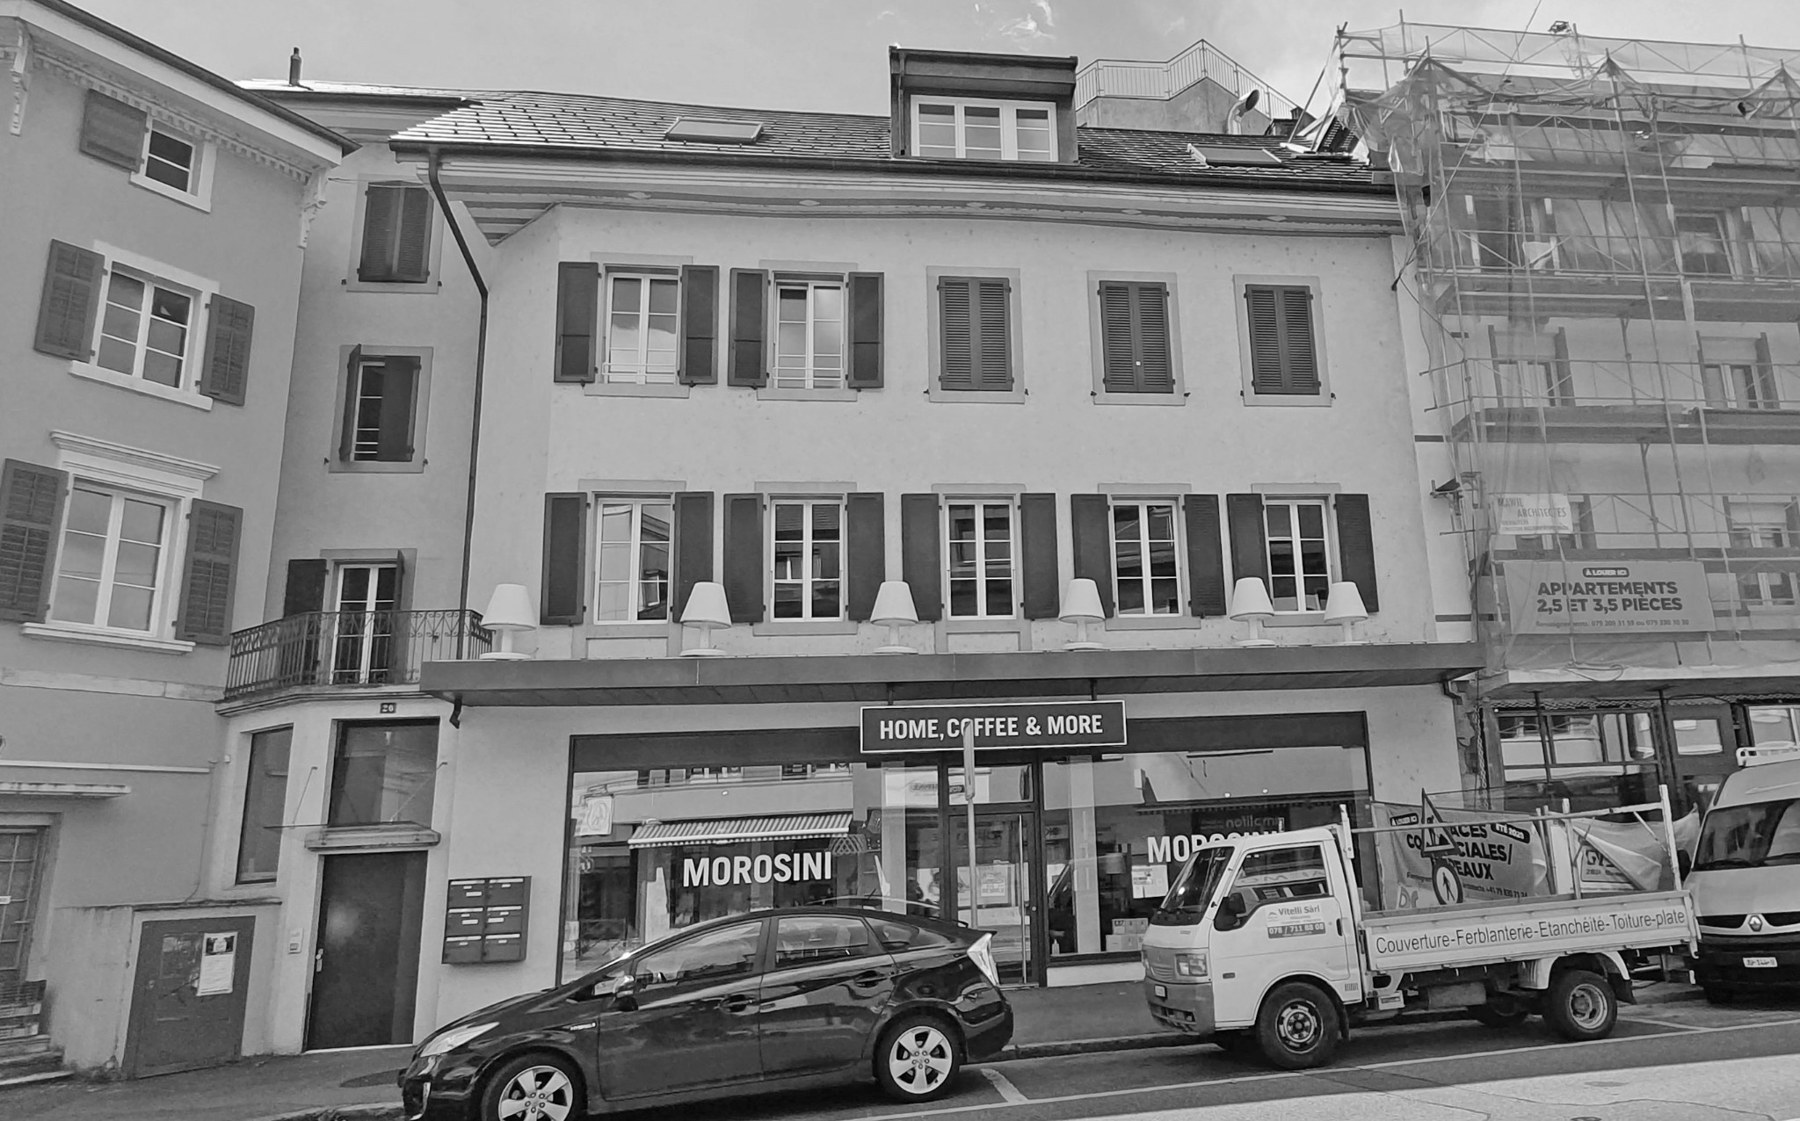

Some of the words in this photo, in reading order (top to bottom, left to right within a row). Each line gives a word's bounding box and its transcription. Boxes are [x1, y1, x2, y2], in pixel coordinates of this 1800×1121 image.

[1537, 581, 1678, 596] APPARTEMENTS
[1536, 598, 1563, 615] 2,5
[1570, 598, 1588, 612] ET
[1593, 598, 1619, 615] 3,5
[1622, 594, 1683, 612] PIÈCES
[1026, 715, 1042, 736] &
[1047, 714, 1103, 735] MORE
[682, 851, 832, 888] MOROSINI
[1278, 905, 1303, 916] Vitelli
